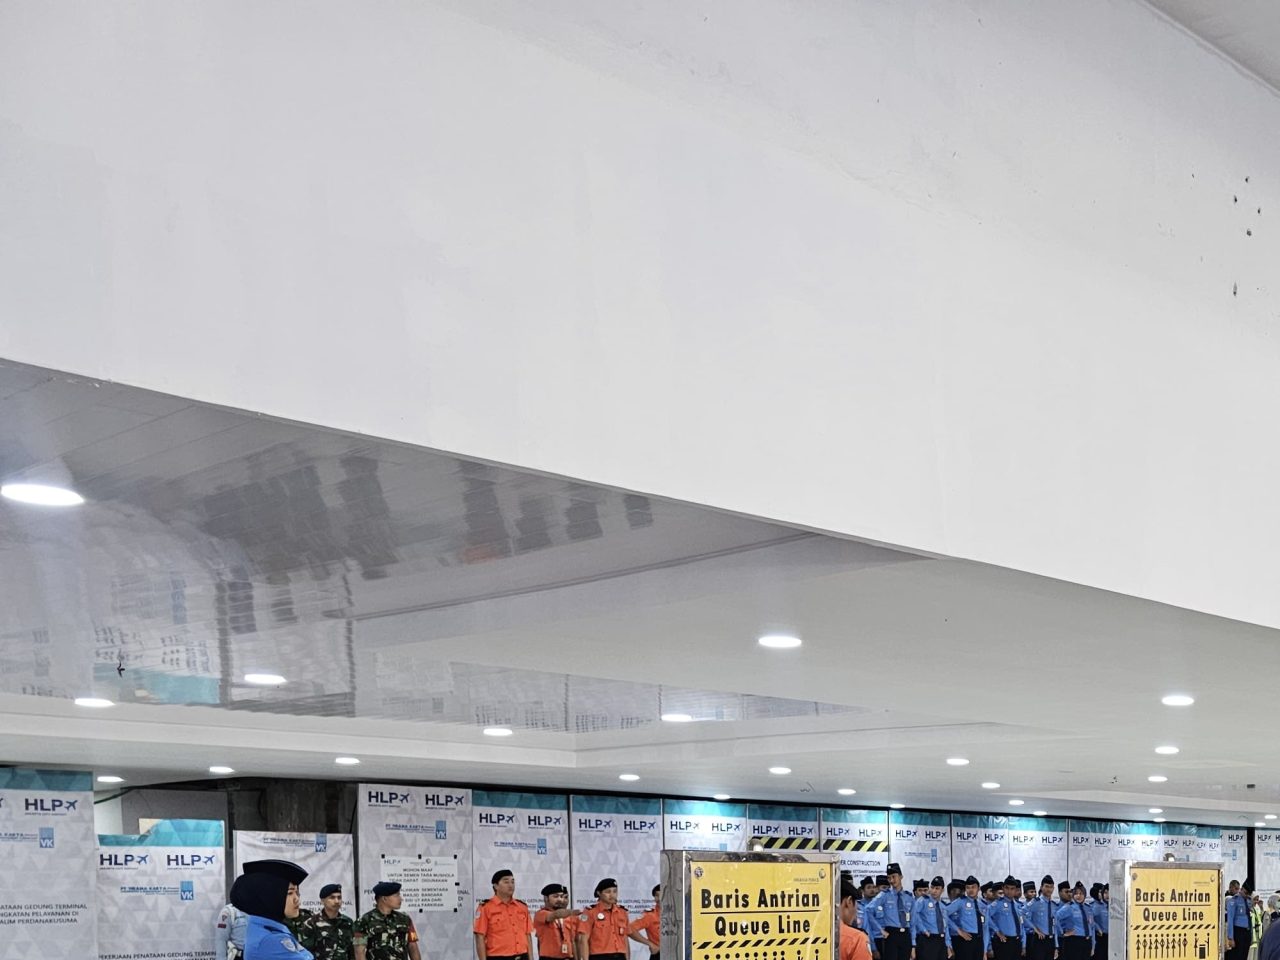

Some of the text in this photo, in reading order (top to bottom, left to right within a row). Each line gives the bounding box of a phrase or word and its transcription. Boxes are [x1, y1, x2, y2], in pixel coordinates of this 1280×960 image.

[368, 791, 398, 803] HLP
[425, 794, 453, 806] HLP
[25, 798, 63, 811] HLP
[479, 813, 505, 824] HLP
[528, 815, 552, 826] HLP
[579, 819, 602, 829] HLP
[624, 820, 646, 830] HLP
[670, 821, 692, 830] HLP
[712, 823, 732, 832] HLP
[753, 825, 772, 835] HLP
[789, 826, 807, 835] HLP
[827, 827, 843, 836] HLP
[859, 829, 876, 837] HLP
[896, 830, 911, 838] HLP
[925, 830, 940, 839] HLP
[957, 832, 971, 840] HLP
[985, 833, 999, 841] HLP
[1013, 835, 1028, 843] HLP
[1073, 836, 1085, 844] HLP
[40, 839, 53, 848] VK
[1095, 837, 1107, 845] HLP
[100, 854, 134, 866] HLP
[167, 854, 201, 866] HLP
[181, 891, 193, 900] VK
[701, 888, 820, 909] Baris Antrian
[1135, 888, 1211, 903] Baris Antrian
[1143, 907, 1204, 922] Queue Line
[715, 915, 811, 937] Queue Line
